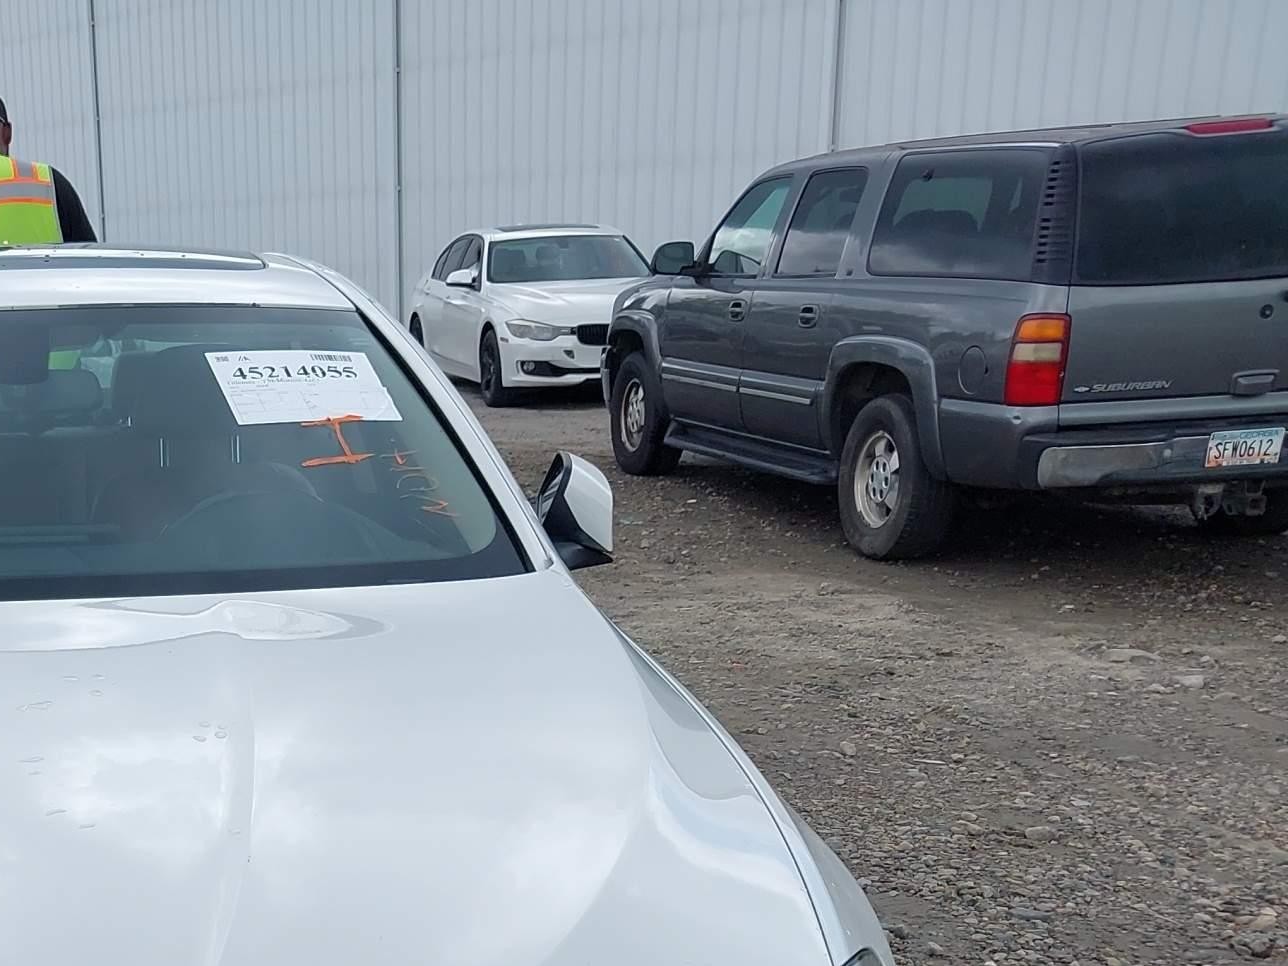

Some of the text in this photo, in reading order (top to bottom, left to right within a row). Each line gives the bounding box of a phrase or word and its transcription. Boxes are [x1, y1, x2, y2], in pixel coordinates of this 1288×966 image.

[232, 365, 358, 380] 45214055
[1090, 381, 1173, 393] SUBURBAN
[1214, 439, 1274, 460] SFW0612
